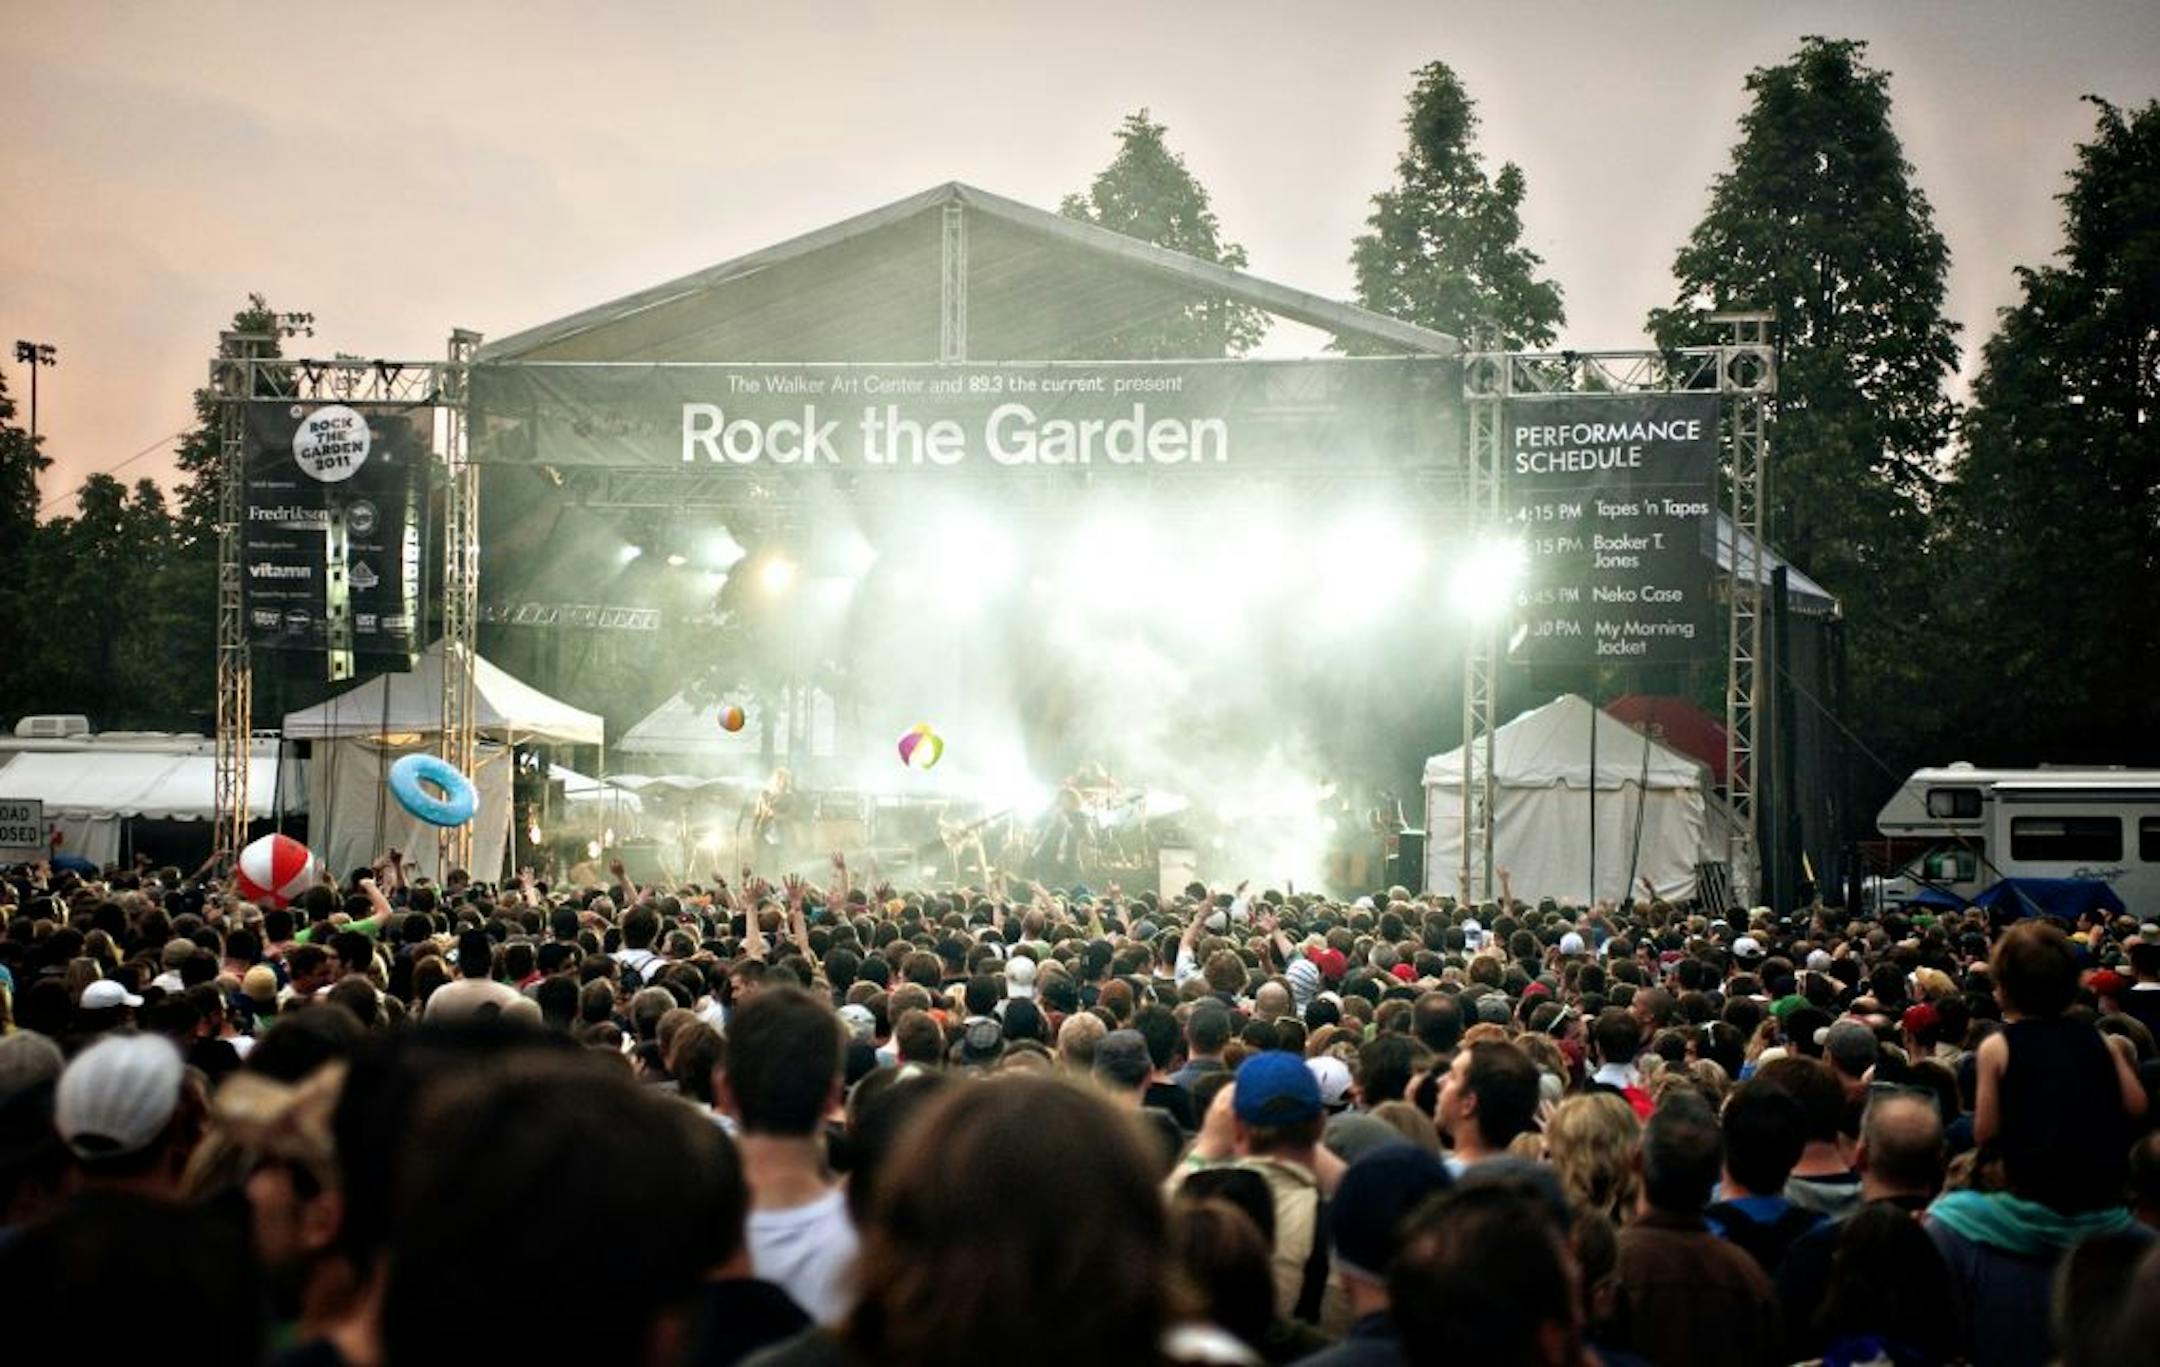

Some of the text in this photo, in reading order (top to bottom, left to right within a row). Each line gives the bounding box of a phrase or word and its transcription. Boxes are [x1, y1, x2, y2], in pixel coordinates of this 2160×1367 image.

[727, 375, 1183, 396] The Walker Art Center and 89.3 the current present
[310, 418, 353, 433] ROCK
[682, 402, 1229, 465] Rock the Garden
[1515, 419, 1701, 448] PERFORMANCE
[314, 430, 347, 443] THE
[301, 440, 363, 458] GARDEN
[315, 456, 351, 471] 2011
[1515, 445, 1643, 474] SCHEDULE
[1517, 498, 1710, 522] 4:15 PM Tapes 'n Tapes
[1558, 536, 1583, 553] PM
[1593, 532, 1649, 550] Booker
[1652, 532, 1667, 550] T.
[1593, 552, 1641, 569] Jones
[1559, 586, 1580, 602] PM
[1592, 584, 1638, 602] Neko
[1641, 585, 1684, 602] Case
[1556, 619, 1582, 636] PM
[1594, 620, 1620, 639] My
[1623, 619, 1696, 638] Morning
[1596, 638, 1647, 655] Jacket
